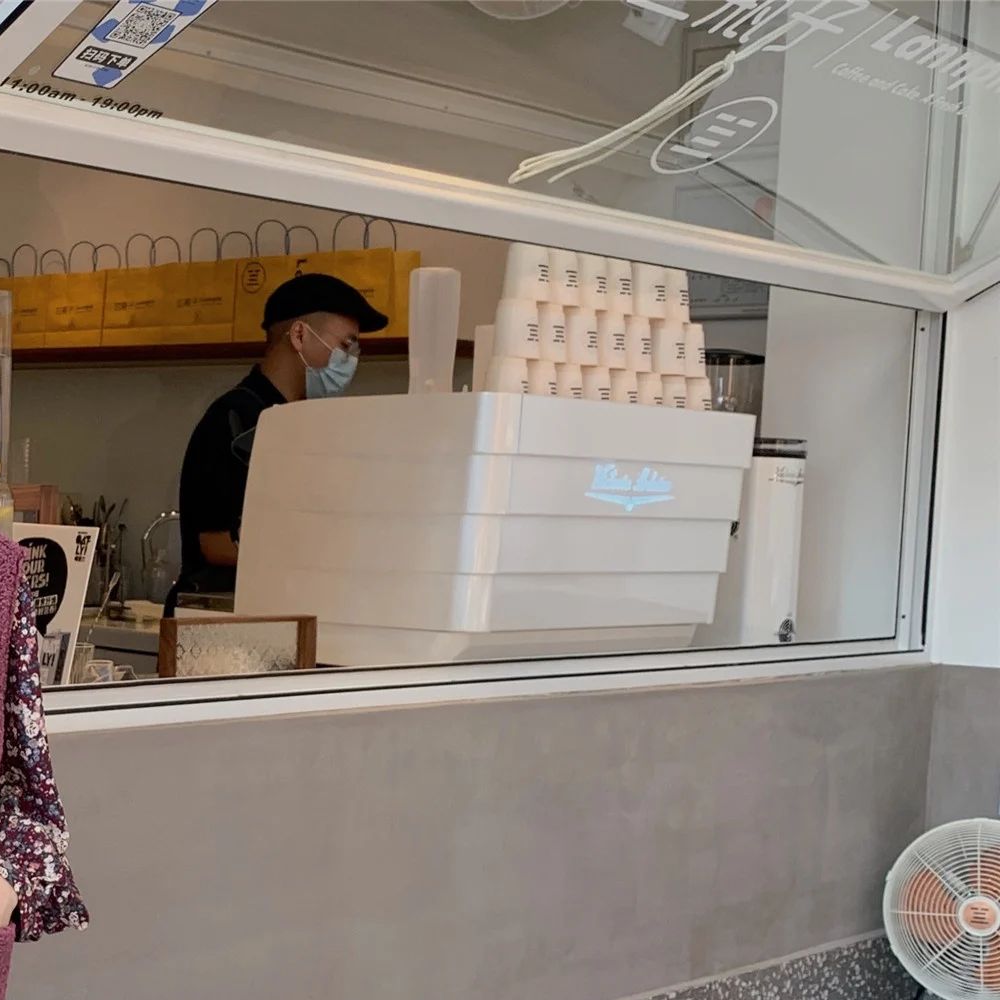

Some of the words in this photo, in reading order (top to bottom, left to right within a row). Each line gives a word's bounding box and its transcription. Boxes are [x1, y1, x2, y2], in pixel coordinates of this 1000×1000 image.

[80, 48, 133, 68] 扫码下单
[831, 61, 871, 84] Coffee
[91, 96, 164, 120] 19:00pm
